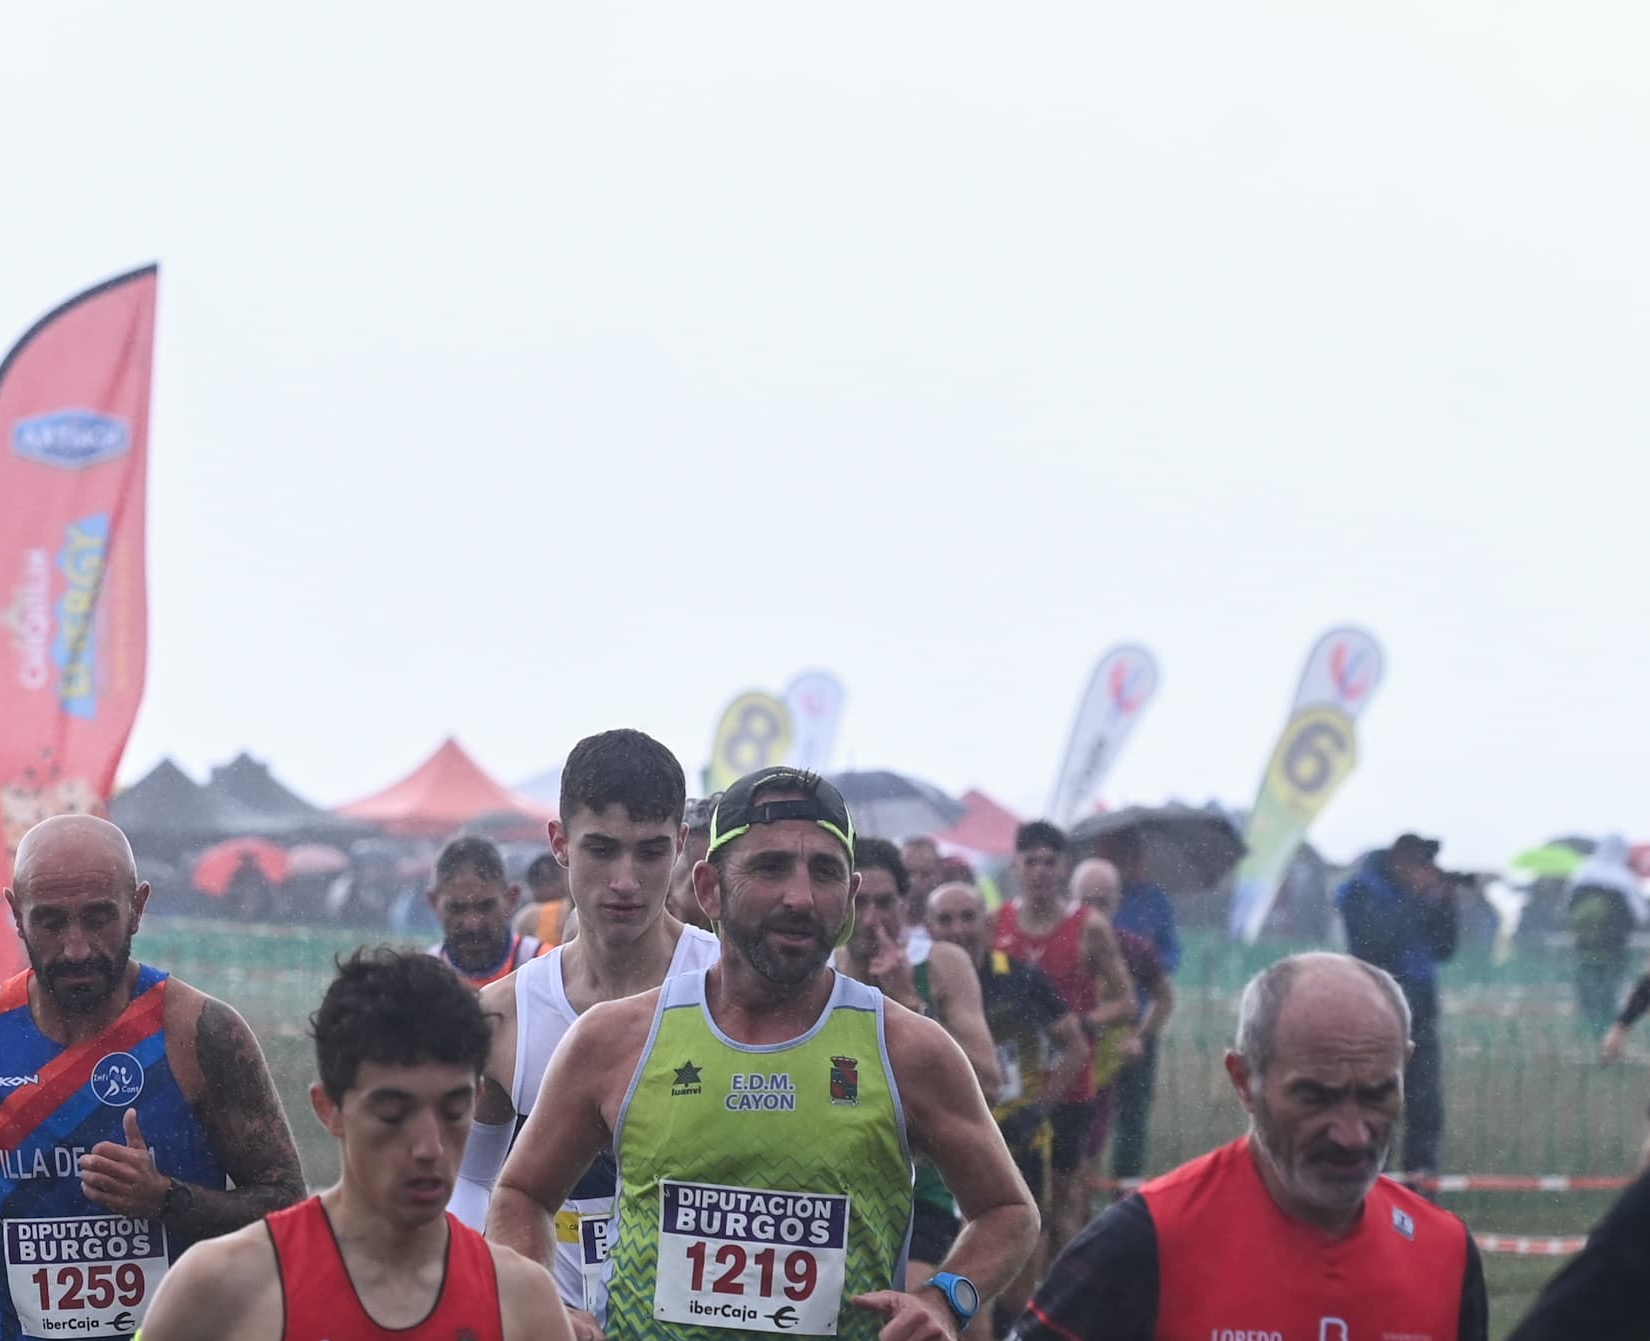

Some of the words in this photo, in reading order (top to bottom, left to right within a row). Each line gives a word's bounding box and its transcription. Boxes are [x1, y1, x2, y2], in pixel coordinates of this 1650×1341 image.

[1282, 719, 1348, 794] 6
[671, 1087, 702, 1097] luanvi
[731, 1073, 795, 1092] E.D.M.
[724, 1093, 796, 1111] CAYON
[54, 1146, 85, 1177] DE
[678, 1187, 832, 1219] DIPUTACIÓN
[18, 1218, 149, 1240] DIPUTACIÓN
[676, 1207, 831, 1244] BURGOS
[19, 1235, 151, 1261] BURGOS
[686, 1241, 818, 1302] 1219
[32, 1263, 146, 1311] 1259
[689, 1300, 758, 1322] iberCaja
[42, 1317, 100, 1332] iberCaja
